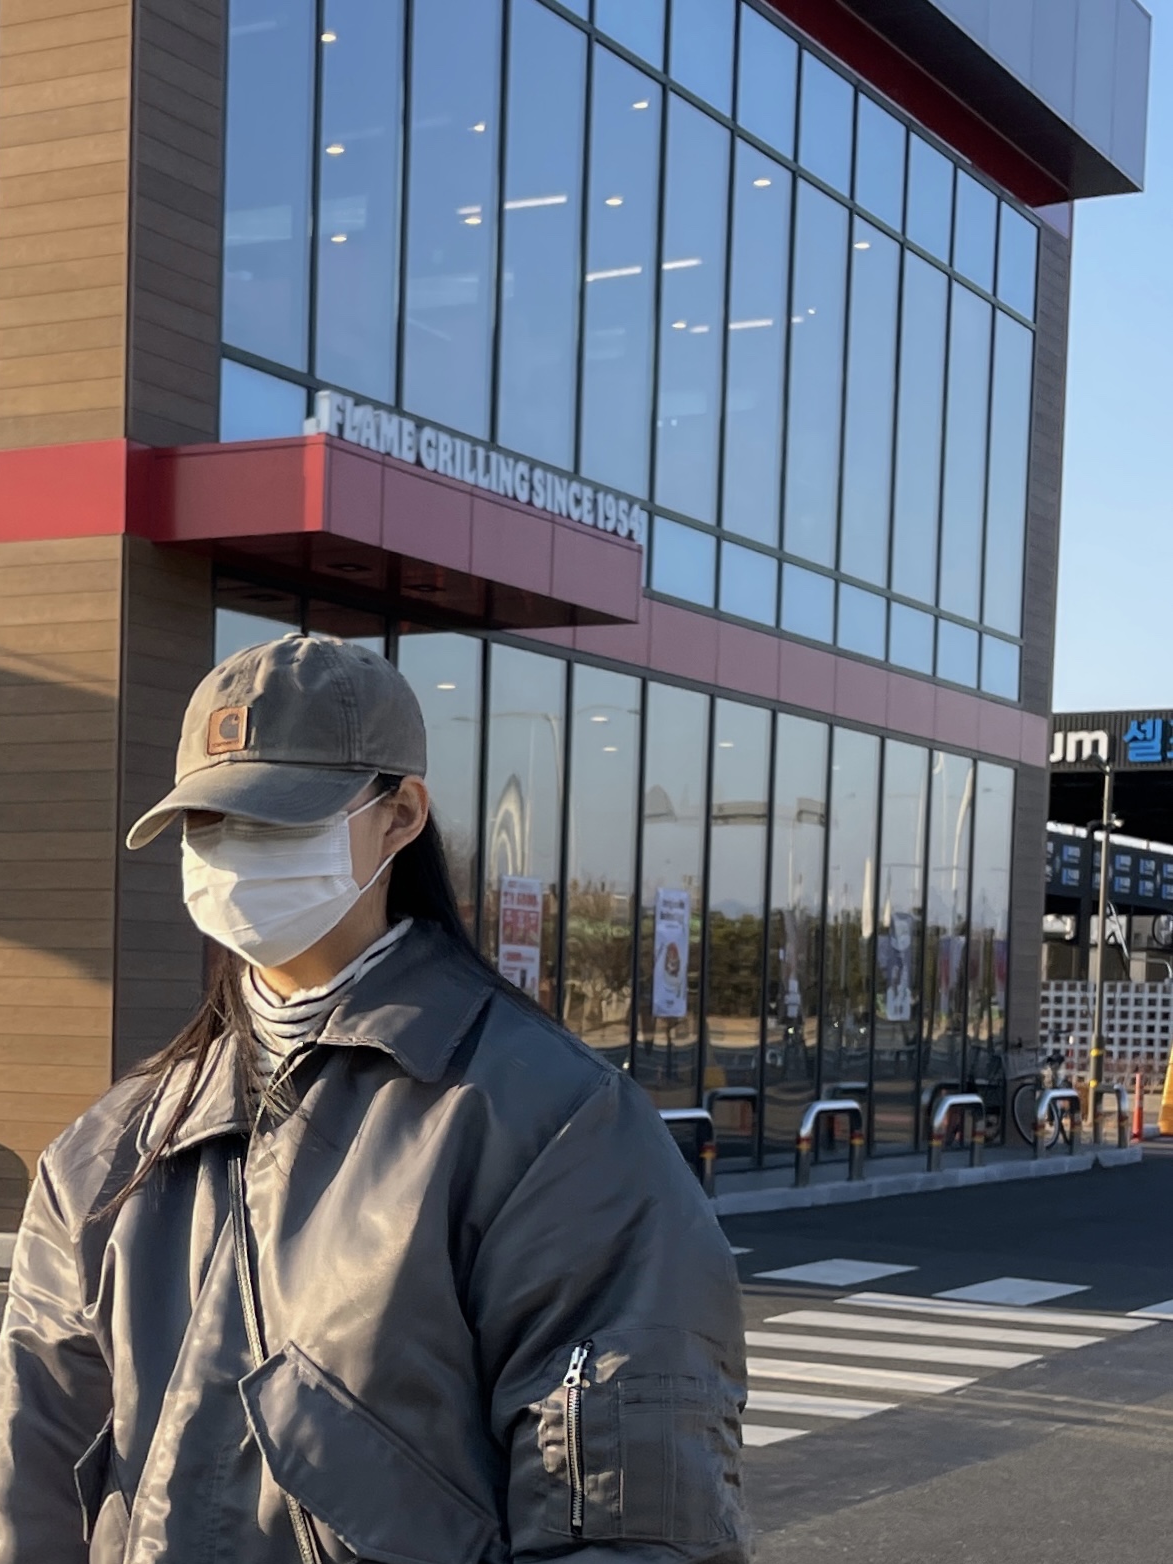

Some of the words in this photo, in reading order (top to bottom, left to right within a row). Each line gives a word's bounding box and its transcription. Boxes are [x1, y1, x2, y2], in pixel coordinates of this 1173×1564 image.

[322, 391, 418, 464] FLAME
[420, 426, 530, 503] GRILLING
[531, 467, 595, 526] SINCE
[596, 491, 646, 545] 1954
[1123, 718, 1173, 763] 셀
